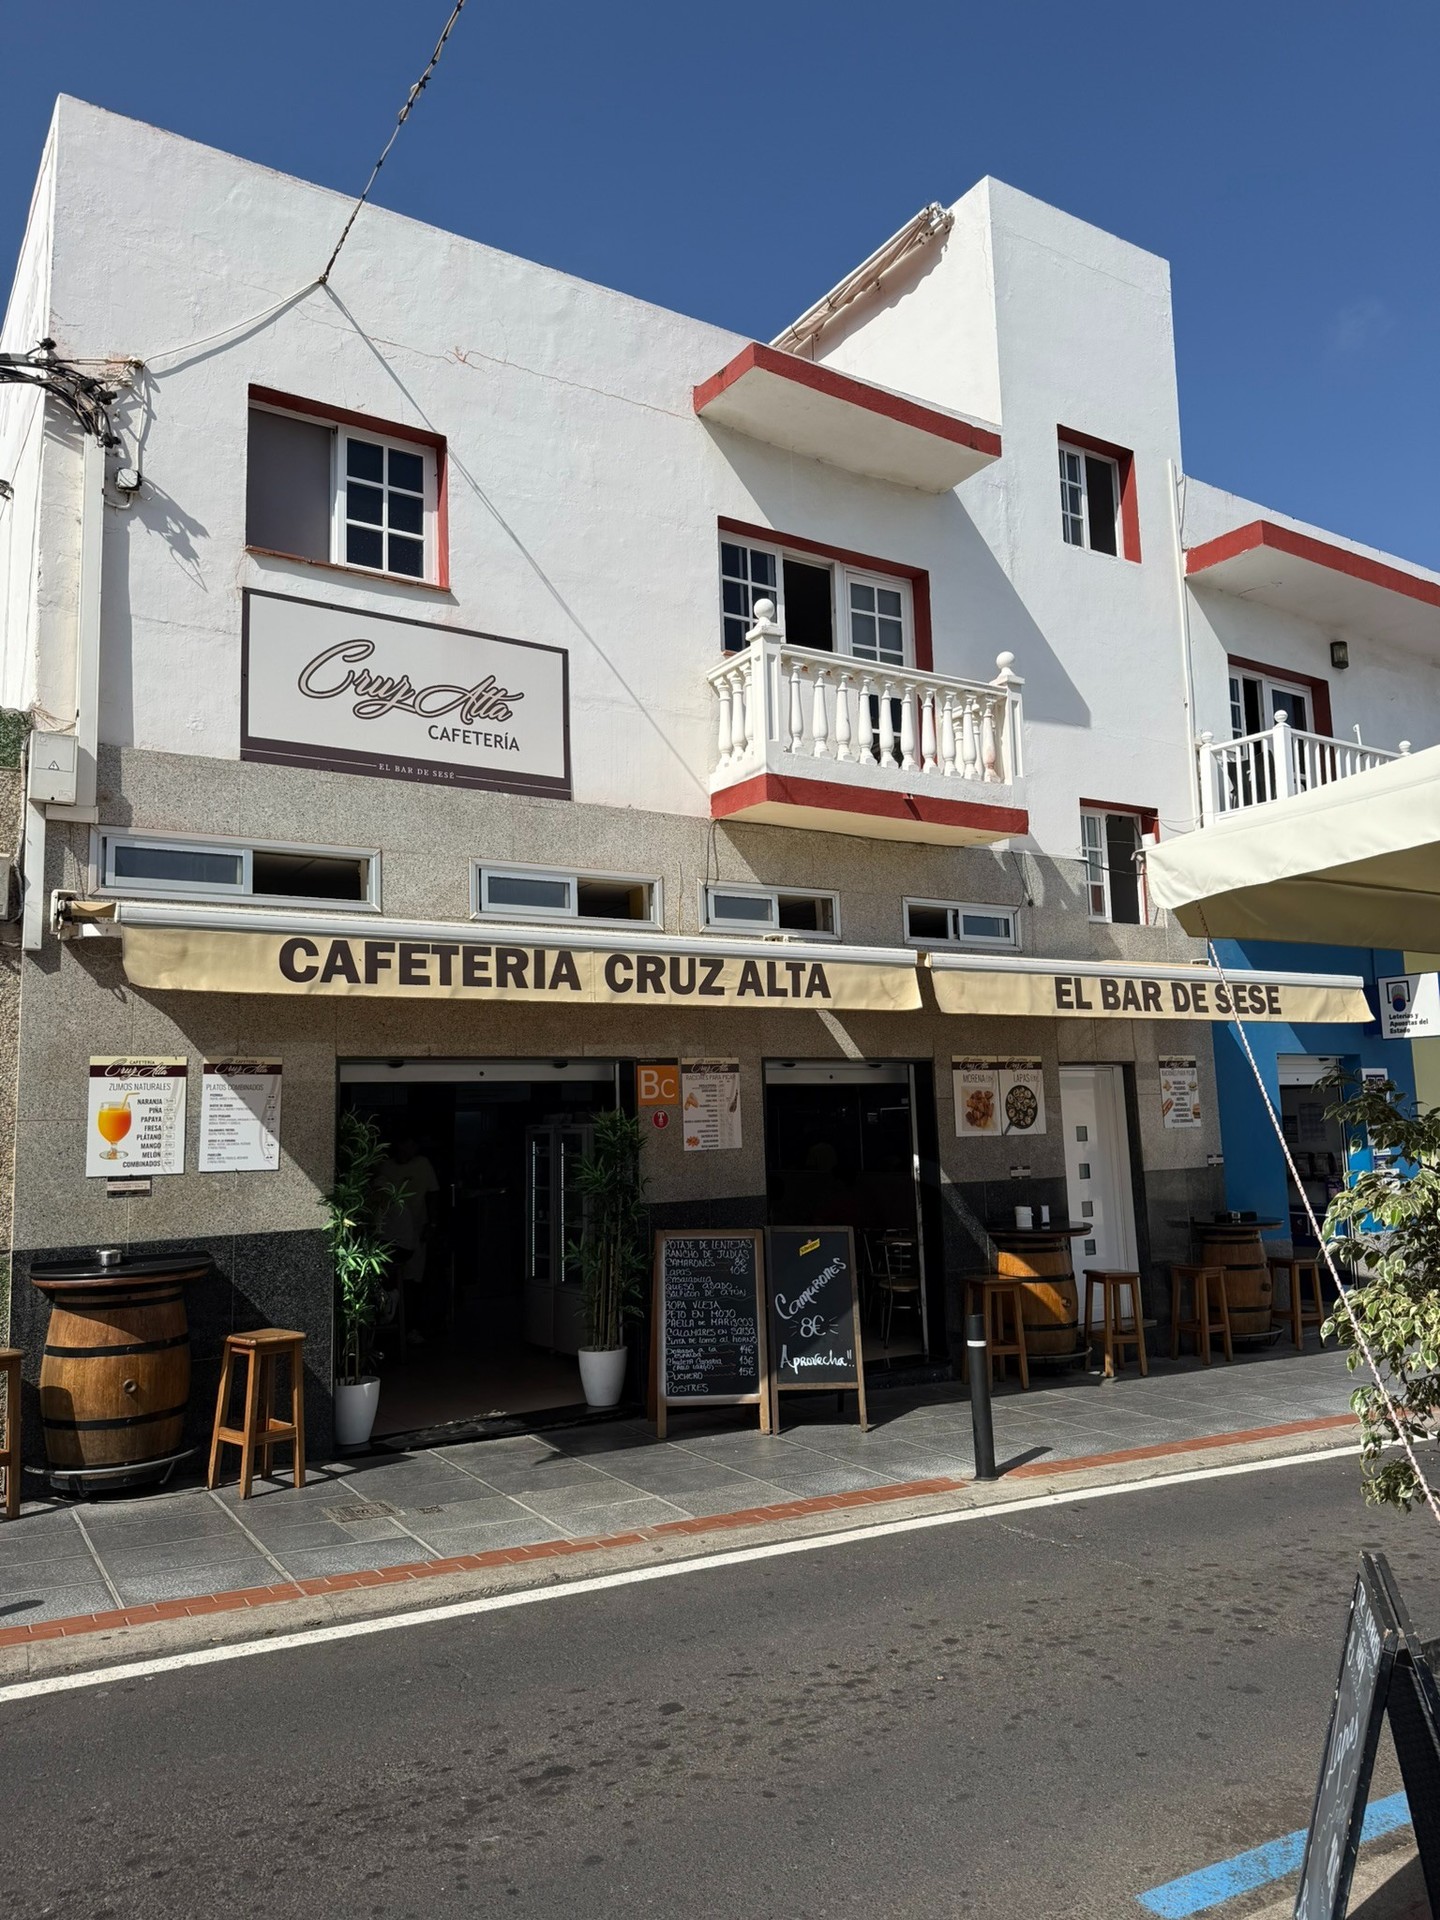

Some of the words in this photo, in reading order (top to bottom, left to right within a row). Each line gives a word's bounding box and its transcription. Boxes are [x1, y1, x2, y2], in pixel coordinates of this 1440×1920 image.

[298, 639, 415, 719] Cruz
[414, 675, 525, 725] Alta
[428, 725, 520, 751] CAFETERÍA
[379, 763, 391, 771] EL
[395, 765, 413, 774] BAR
[417, 768, 429, 776] DE
[279, 937, 582, 991] CAFETERIA
[604, 954, 725, 996] CRUZ
[737, 960, 832, 998] ALTA
[1054, 977, 1092, 1010] EL
[1100, 979, 1163, 1012] BAR
[1171, 982, 1209, 1013] DE
[1215, 983, 1282, 1015] SESE
[1390, 1020, 1417, 1028] Apuestas
[104, 1058, 139, 1081] Cruz
[138, 1062, 172, 1078] Alta
[1013, 1073, 1030, 1082] LAPAS
[109, 1083, 132, 1091] ZUMOS
[134, 1083, 171, 1091] NATURALES
[641, 1070, 675, 1099] Bc
[122, 1160, 161, 1168] COMBINADOS
[665, 1240, 695, 1250] POTAJE
[699, 1241, 709, 1250] DE
[712, 1240, 752, 1250] LENTEJAS
[665, 1250, 699, 1258] RANCHO
[703, 1250, 712, 1258] DE
[665, 1258, 715, 1267] CAMARONES
[735, 1257, 747, 1266] 8€
[730, 1266, 748, 1275] 10€
[666, 1301, 687, 1309] ROPA
[665, 1311, 686, 1319] PETO
[711, 1309, 736, 1318] MOJO
[666, 1319, 694, 1327] PAELLA
[711, 1318, 753, 1327] MARISCOS
[800, 1315, 826, 1338] 8€
[740, 1345, 755, 1354] 14€
[739, 1356, 754, 1366] 13€
[738, 1367, 756, 1376] 15€
